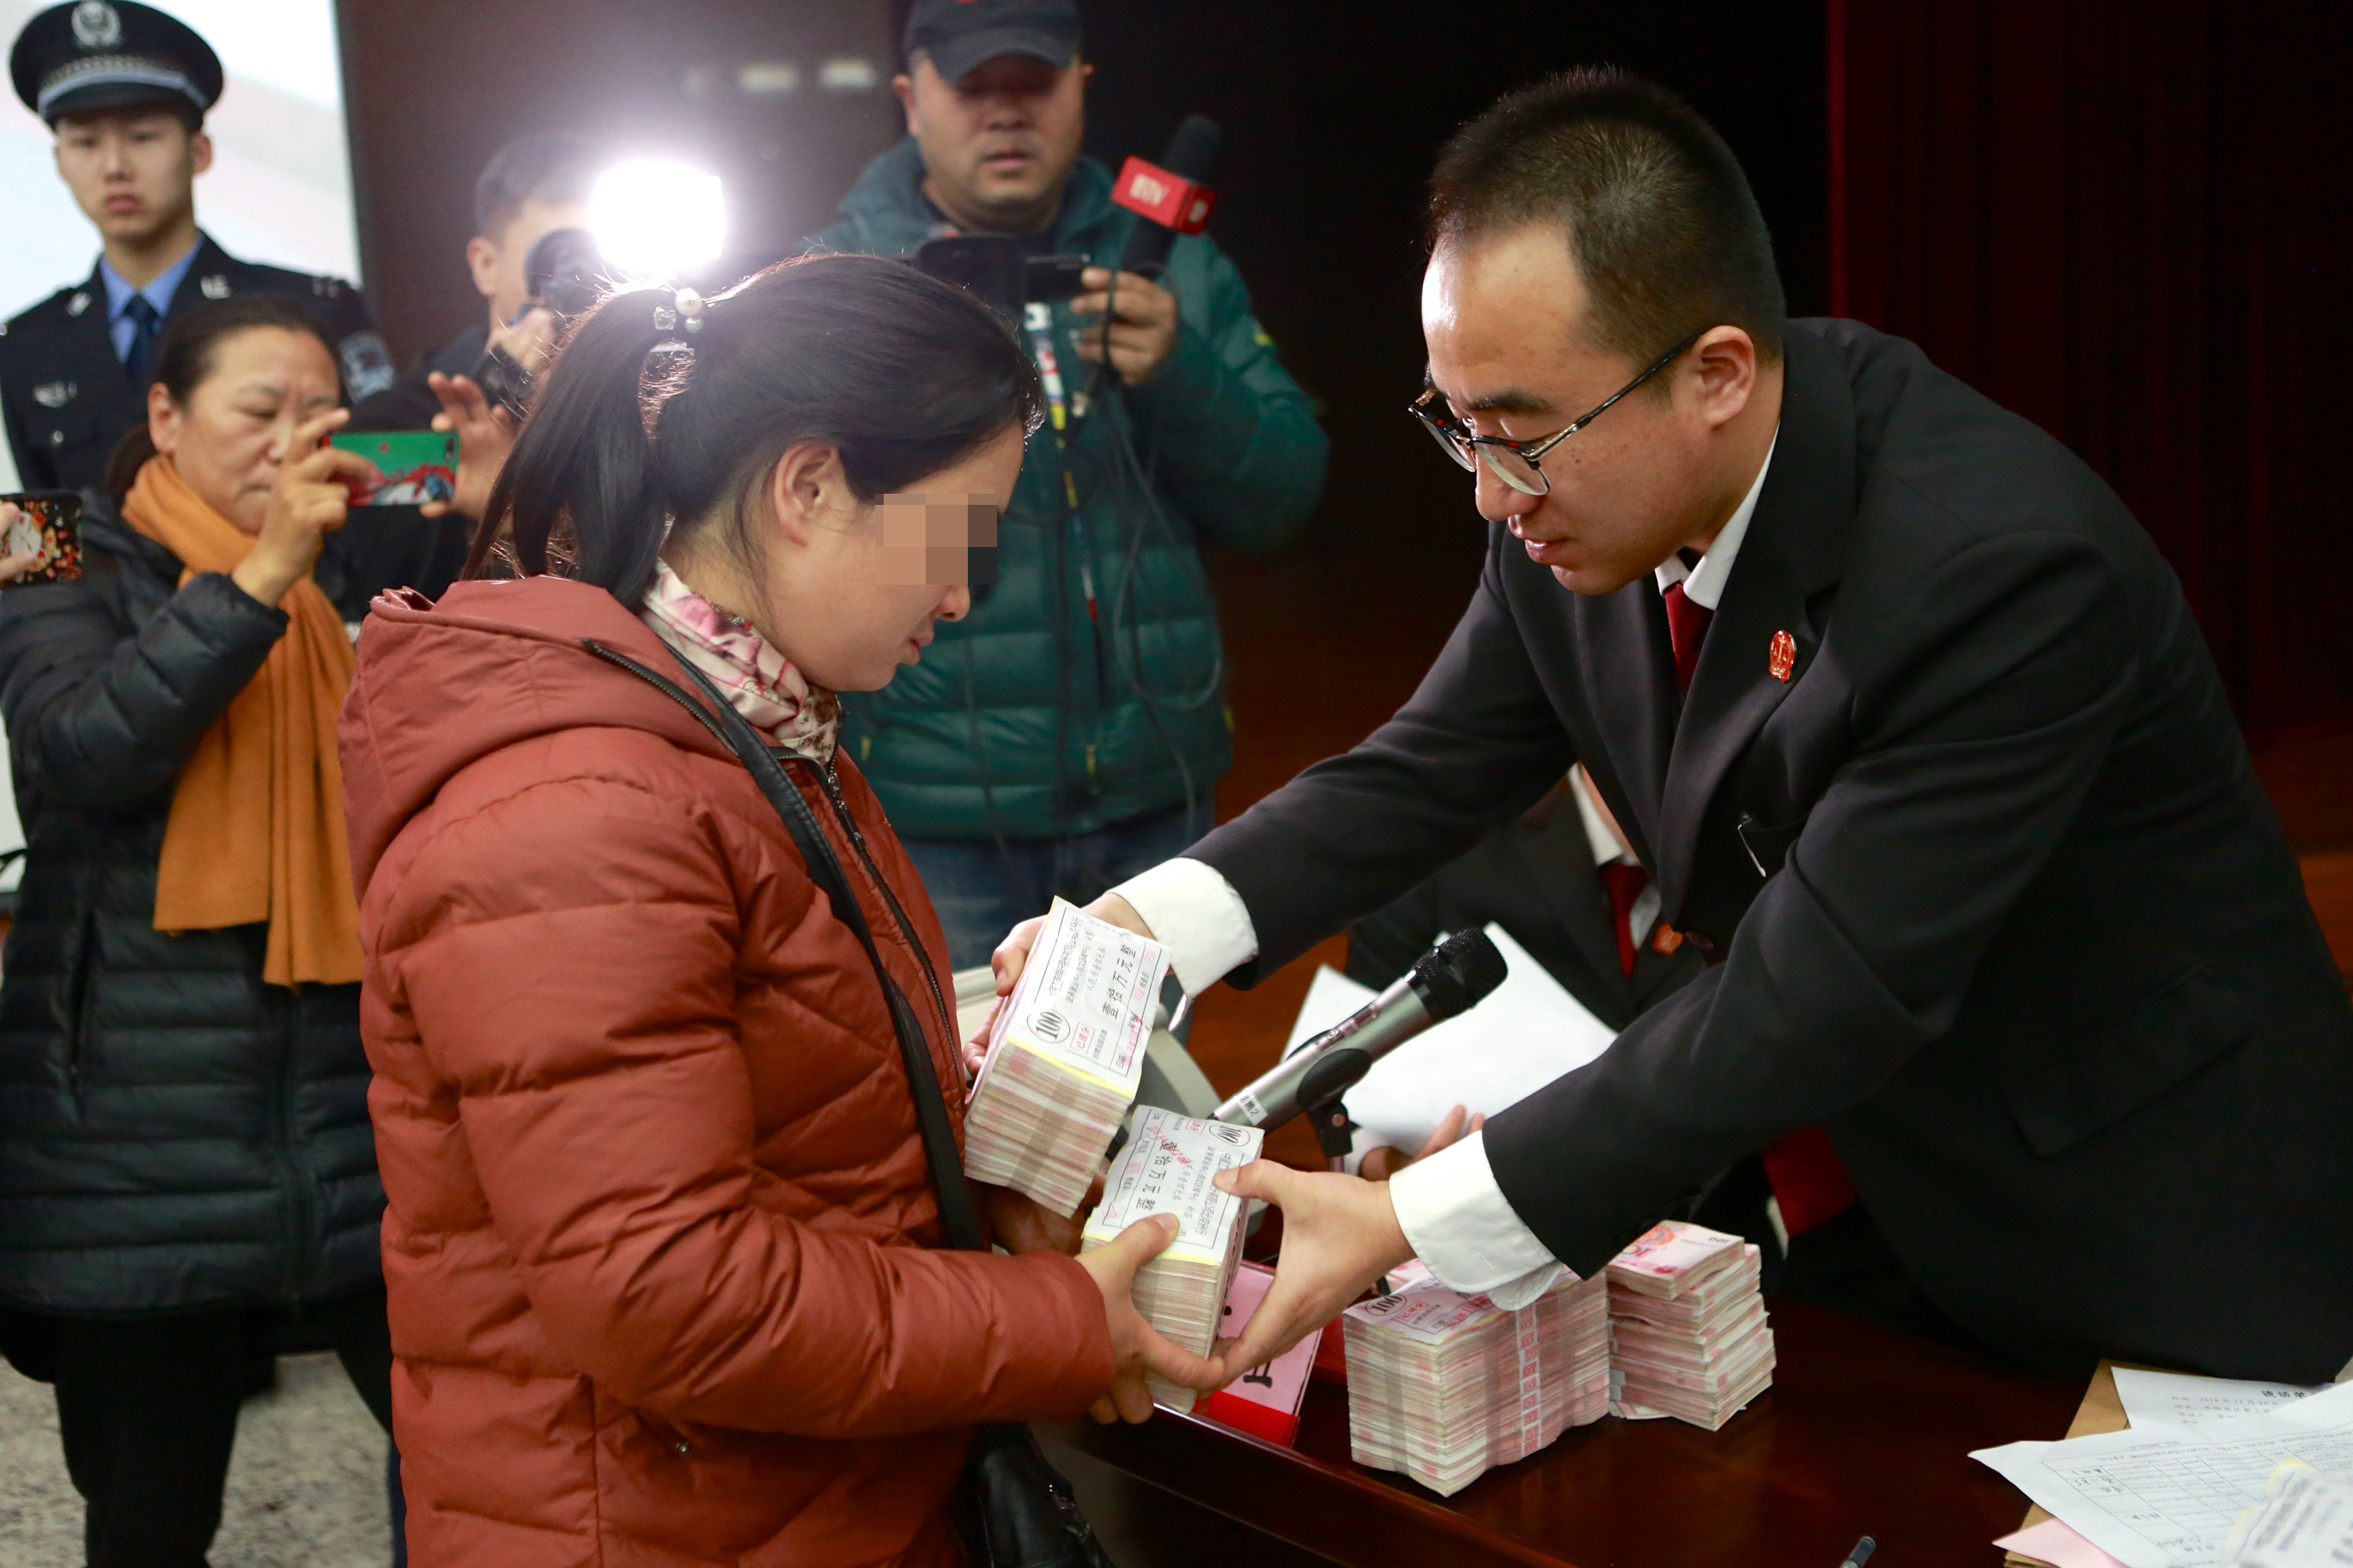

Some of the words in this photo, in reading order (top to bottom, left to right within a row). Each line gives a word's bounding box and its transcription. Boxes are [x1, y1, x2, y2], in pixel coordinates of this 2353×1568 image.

[1101, 944, 1137, 1019] 壹拾万元整
[1035, 1011, 1063, 1040] 100
[1217, 1126, 1242, 1145] 100
[1136, 1141, 1177, 1211] 壹拾万元整
[1371, 1294, 1402, 1313] 100
[2260, 1389, 2320, 1398] 谈话笔
